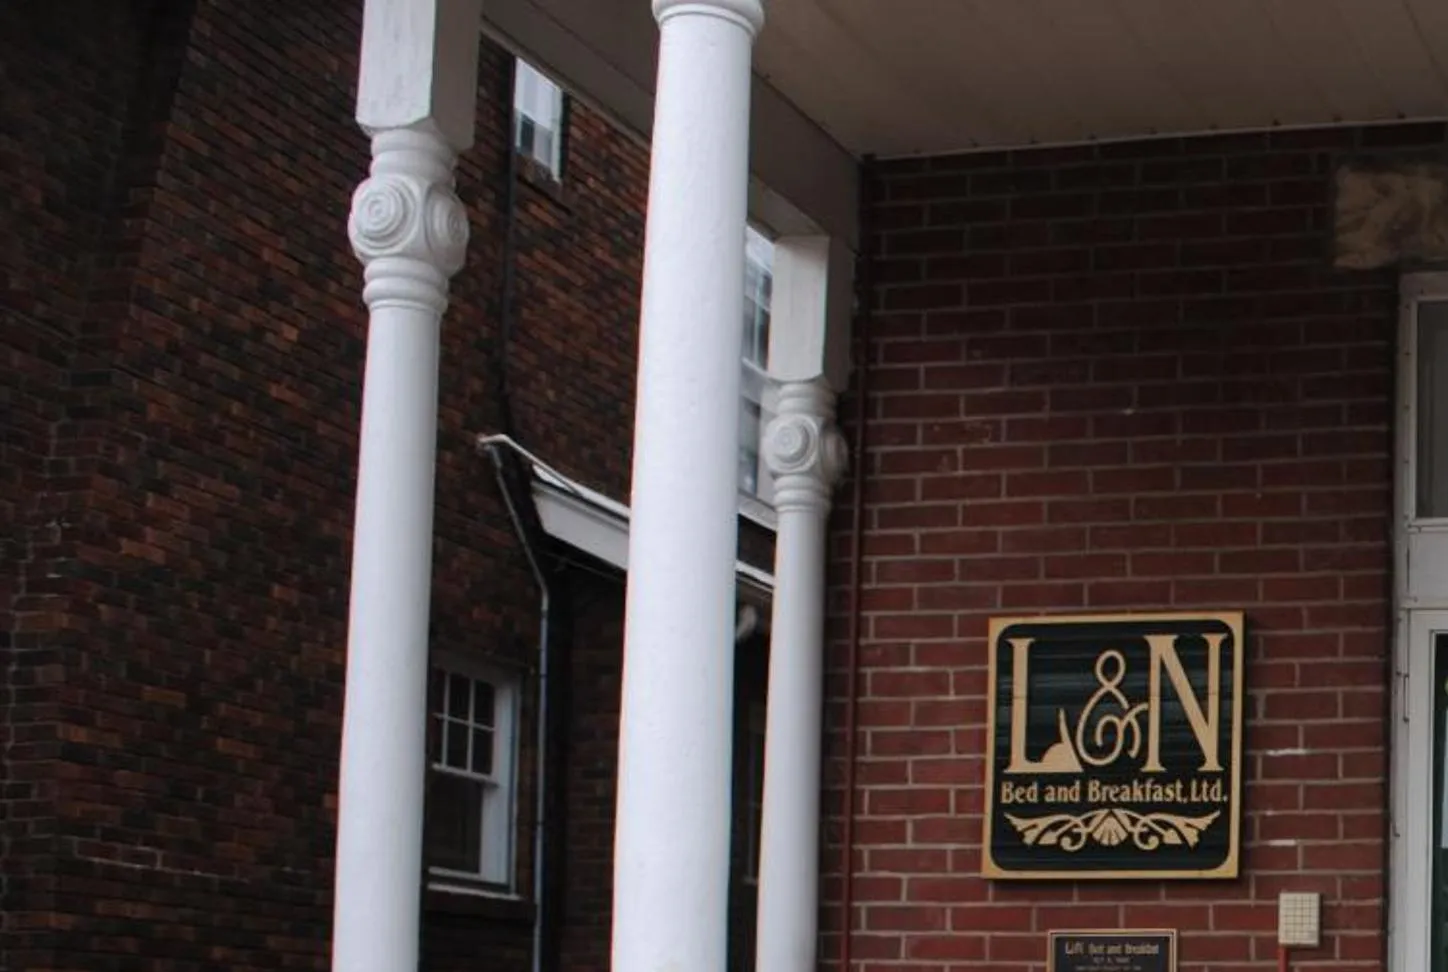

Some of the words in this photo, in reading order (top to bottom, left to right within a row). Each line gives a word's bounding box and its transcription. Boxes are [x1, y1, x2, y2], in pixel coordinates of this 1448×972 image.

[1003, 633, 1228, 773] L&N
[1001, 780, 1039, 803] Bed
[1044, 780, 1081, 803] and
[1190, 779, 1229, 802] Ltd.
